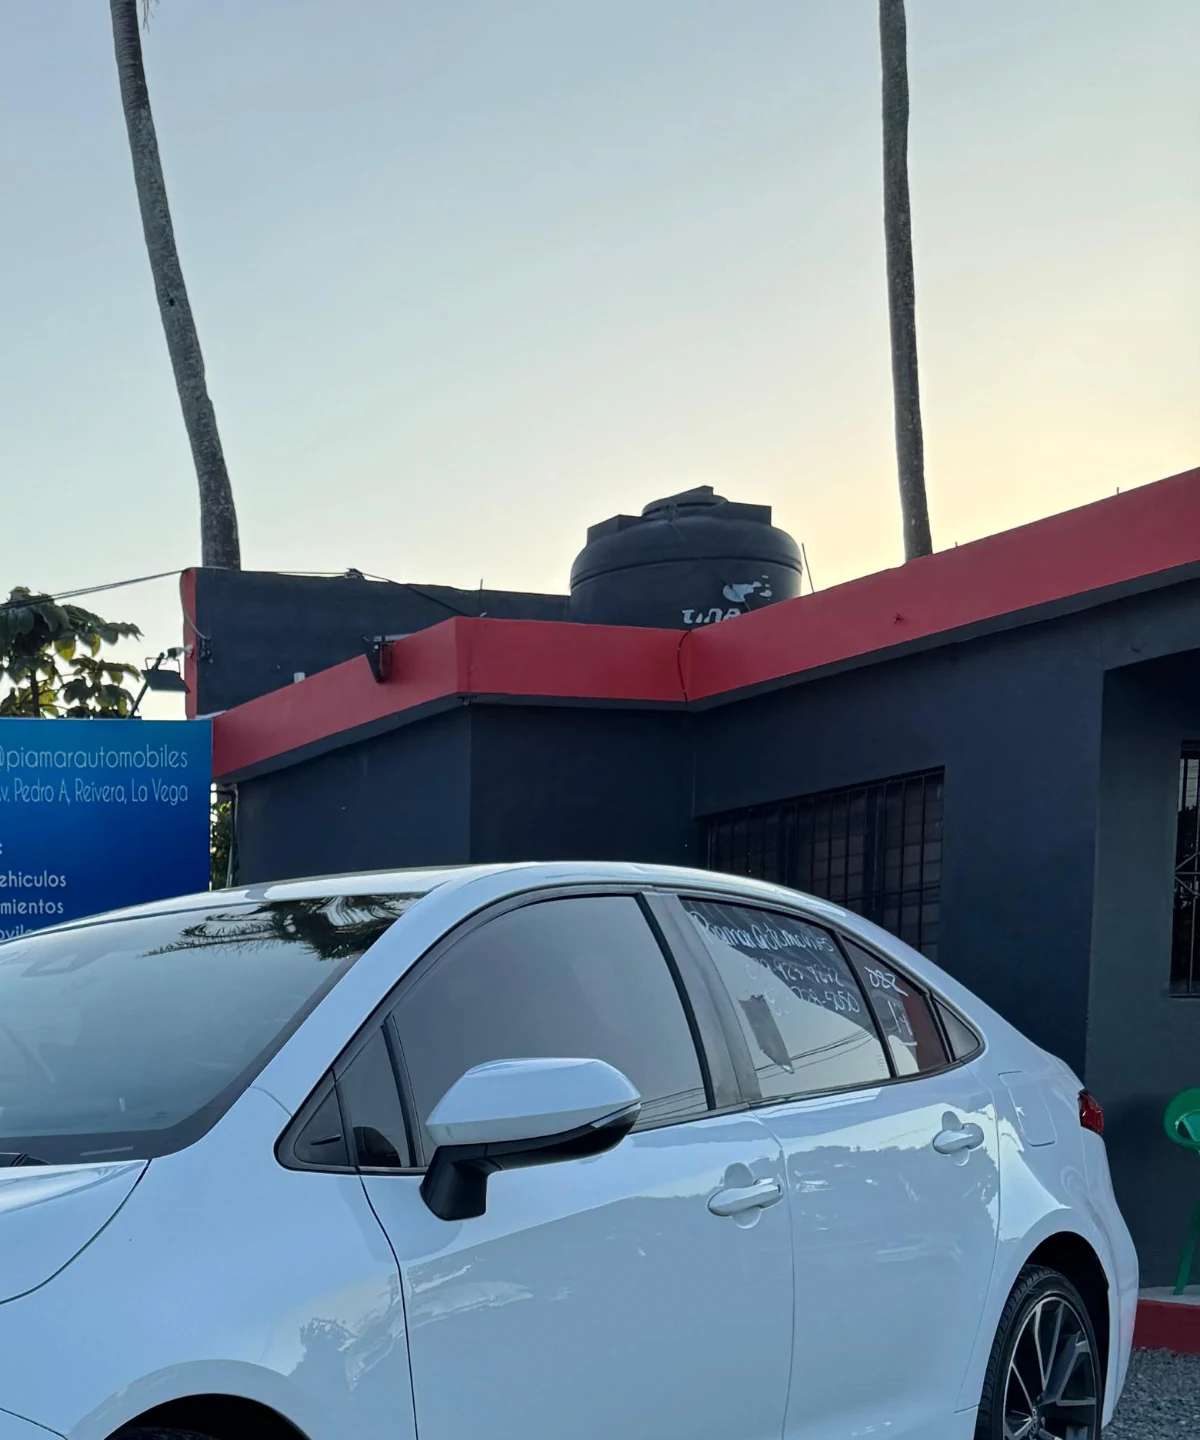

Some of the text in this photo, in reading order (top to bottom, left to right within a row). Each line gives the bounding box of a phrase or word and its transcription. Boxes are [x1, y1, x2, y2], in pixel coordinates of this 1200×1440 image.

[14, 778, 54, 803] Pedro
[131, 778, 148, 802] La
[152, 778, 189, 805] Vega
